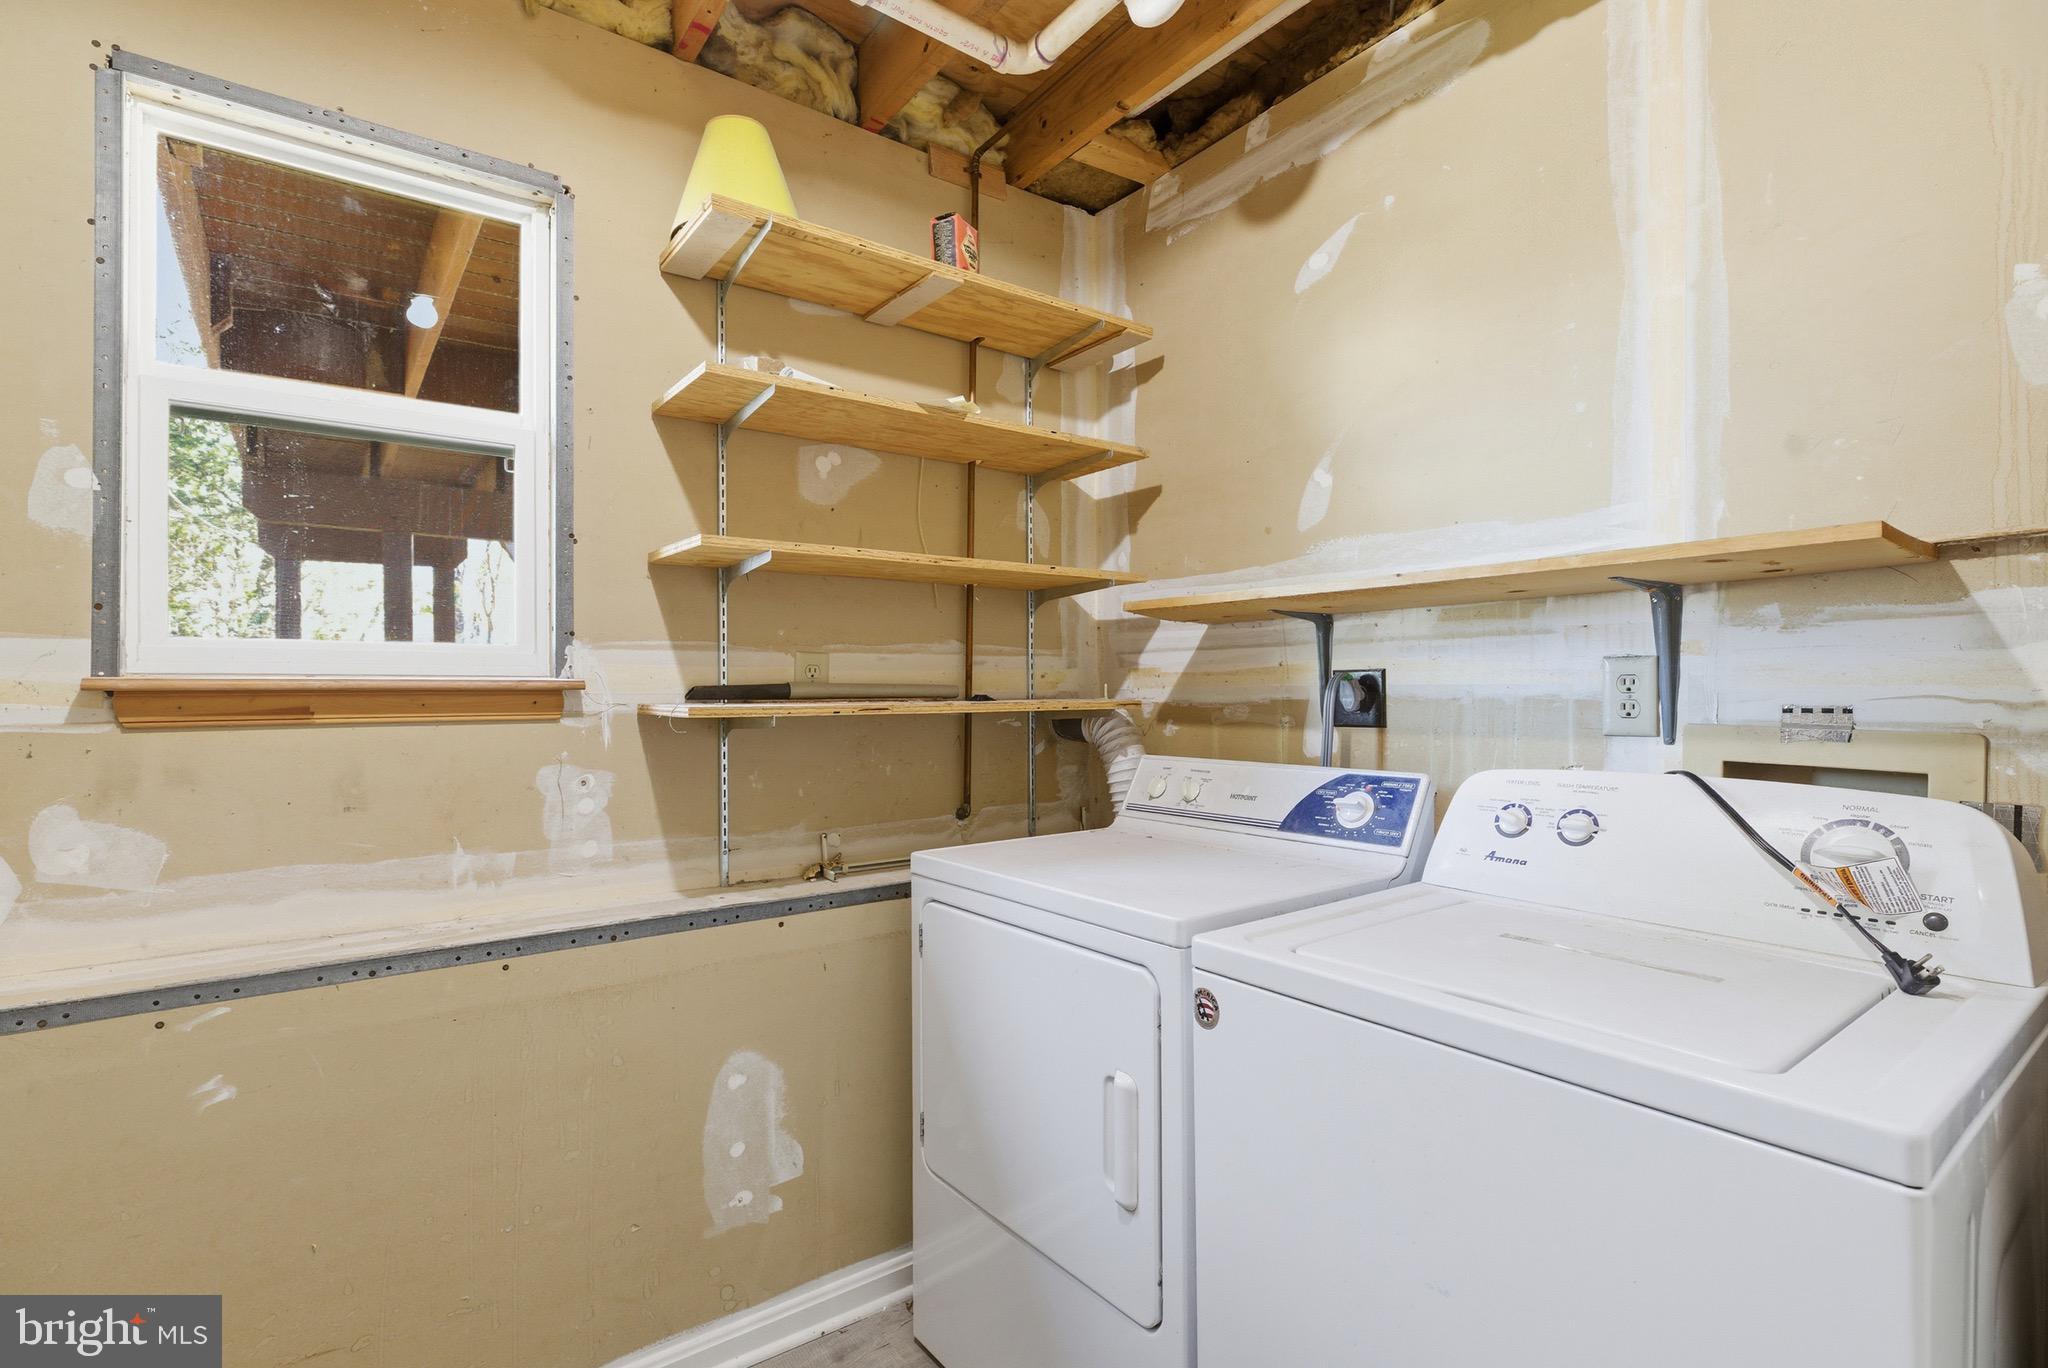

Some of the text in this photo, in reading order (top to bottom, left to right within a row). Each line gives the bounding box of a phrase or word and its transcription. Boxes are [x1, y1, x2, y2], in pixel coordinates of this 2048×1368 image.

[1842, 804, 1879, 814] NORMAL
[1483, 850, 1528, 866] Amana
[1920, 893, 1955, 904] START
[1909, 929, 1937, 937] CANCEL
